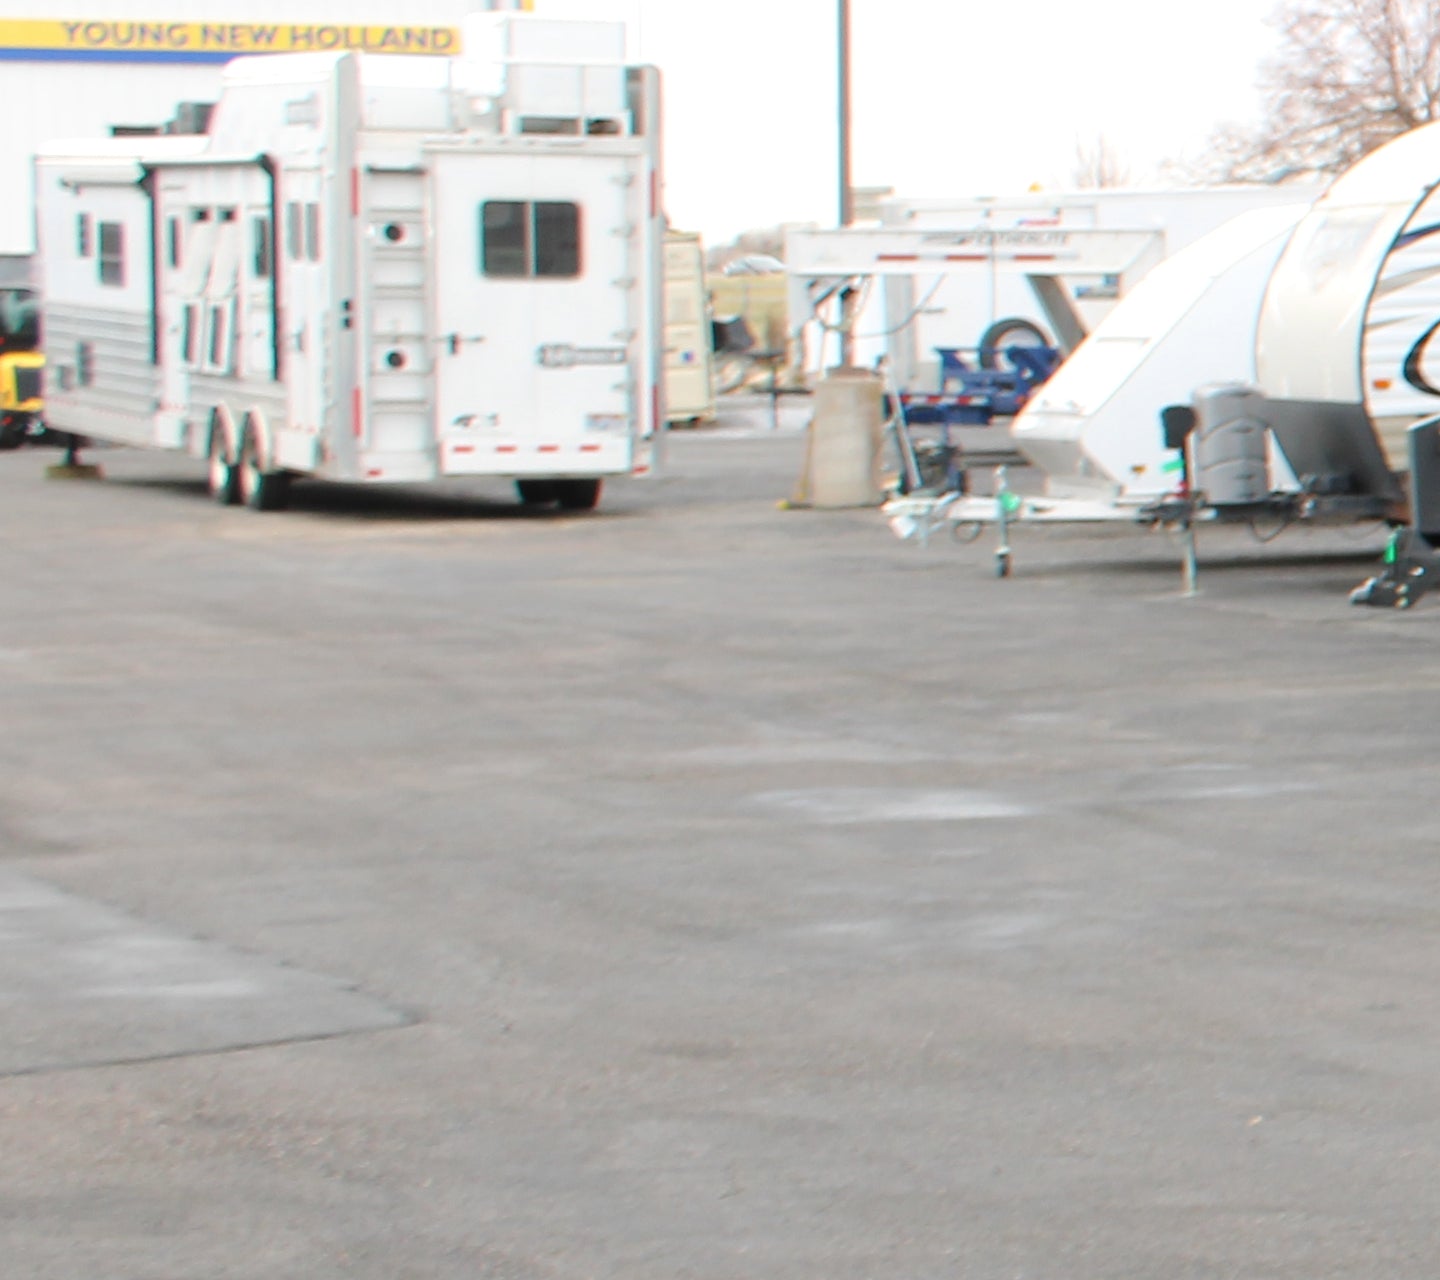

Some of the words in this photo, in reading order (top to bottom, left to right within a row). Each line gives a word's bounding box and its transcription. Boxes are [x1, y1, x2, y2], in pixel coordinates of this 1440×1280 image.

[60, 21, 190, 47] YOUNG
[200, 24, 280, 48] NEW
[287, 26, 455, 51] HOLLAND
